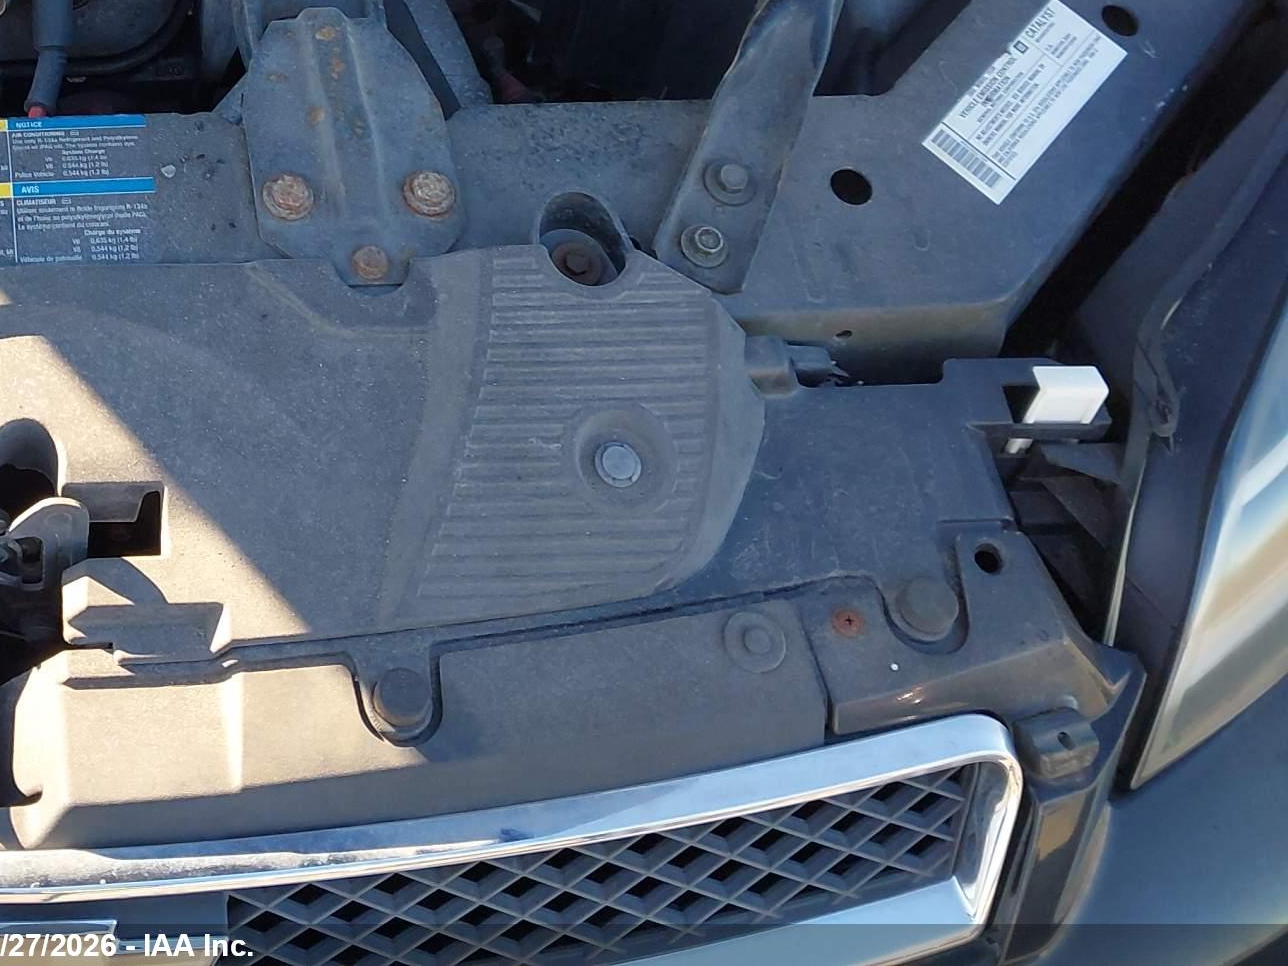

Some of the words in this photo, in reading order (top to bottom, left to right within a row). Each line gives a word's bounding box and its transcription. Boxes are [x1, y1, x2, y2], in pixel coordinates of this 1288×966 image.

[1024, 7, 1056, 40] CATALYST
[958, 98, 979, 120] VEHICLE
[975, 75, 999, 100] EMISSION
[995, 55, 1018, 78] CONTROL
[981, 75, 1011, 107] INFORMATION
[21, 185, 40, 194] AVIS
[108, 237, 117, 245] kg
[109, 245, 118, 253] kg
[109, 253, 118, 261] kg
